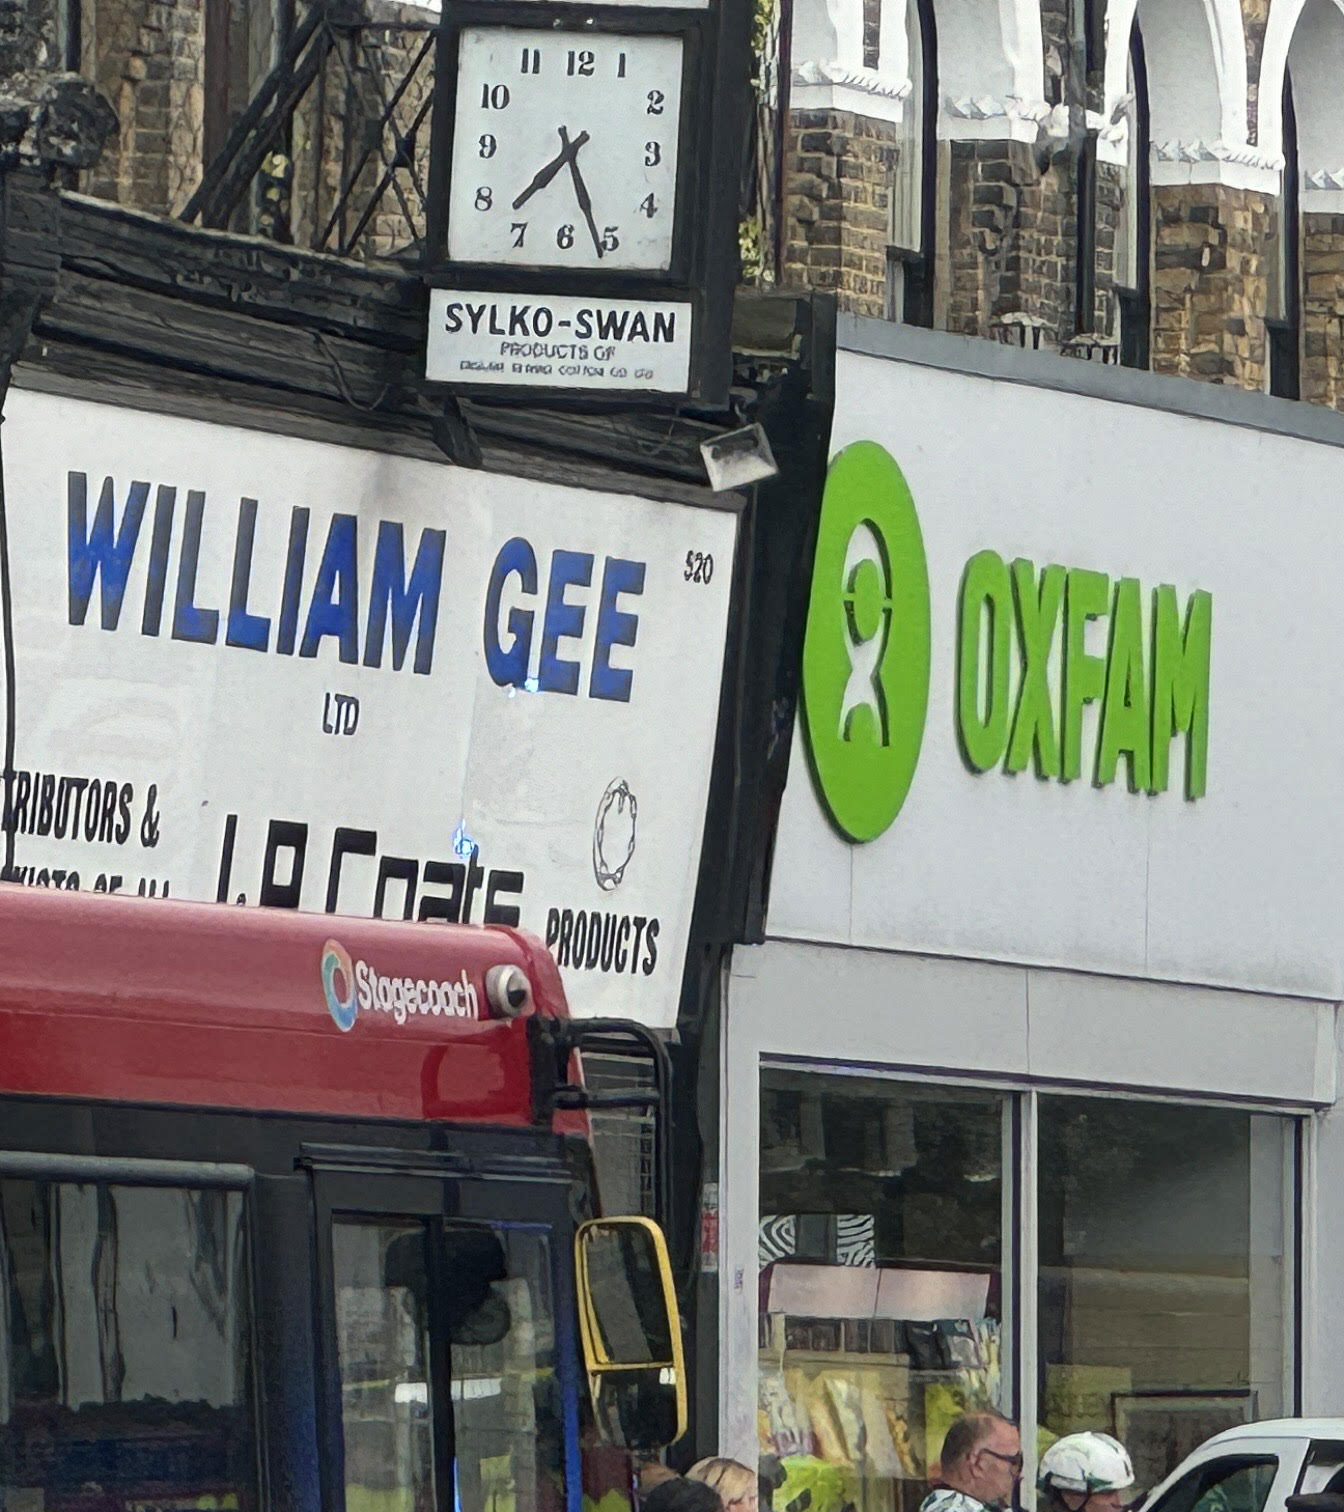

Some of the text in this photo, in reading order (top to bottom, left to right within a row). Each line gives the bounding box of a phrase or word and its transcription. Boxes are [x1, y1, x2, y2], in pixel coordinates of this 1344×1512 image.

[521, 48, 627, 78] 11 12 1
[481, 83, 665, 115] 10 2
[478, 134, 662, 167] 9 3
[474, 186, 658, 218] 8 4
[510, 222, 620, 252] 7 6 5
[445, 302, 676, 343] SYLKO-SWAN
[500, 341, 589, 361] PRODUCTS
[67, 470, 647, 703] WILLIAM GEE
[957, 549, 1213, 802] OXFAM
[321, 691, 359, 735] LTD
[140, 783, 161, 848] &
[546, 905, 660, 976] PRODUCTS
[355, 960, 480, 1026] Stagecoach
